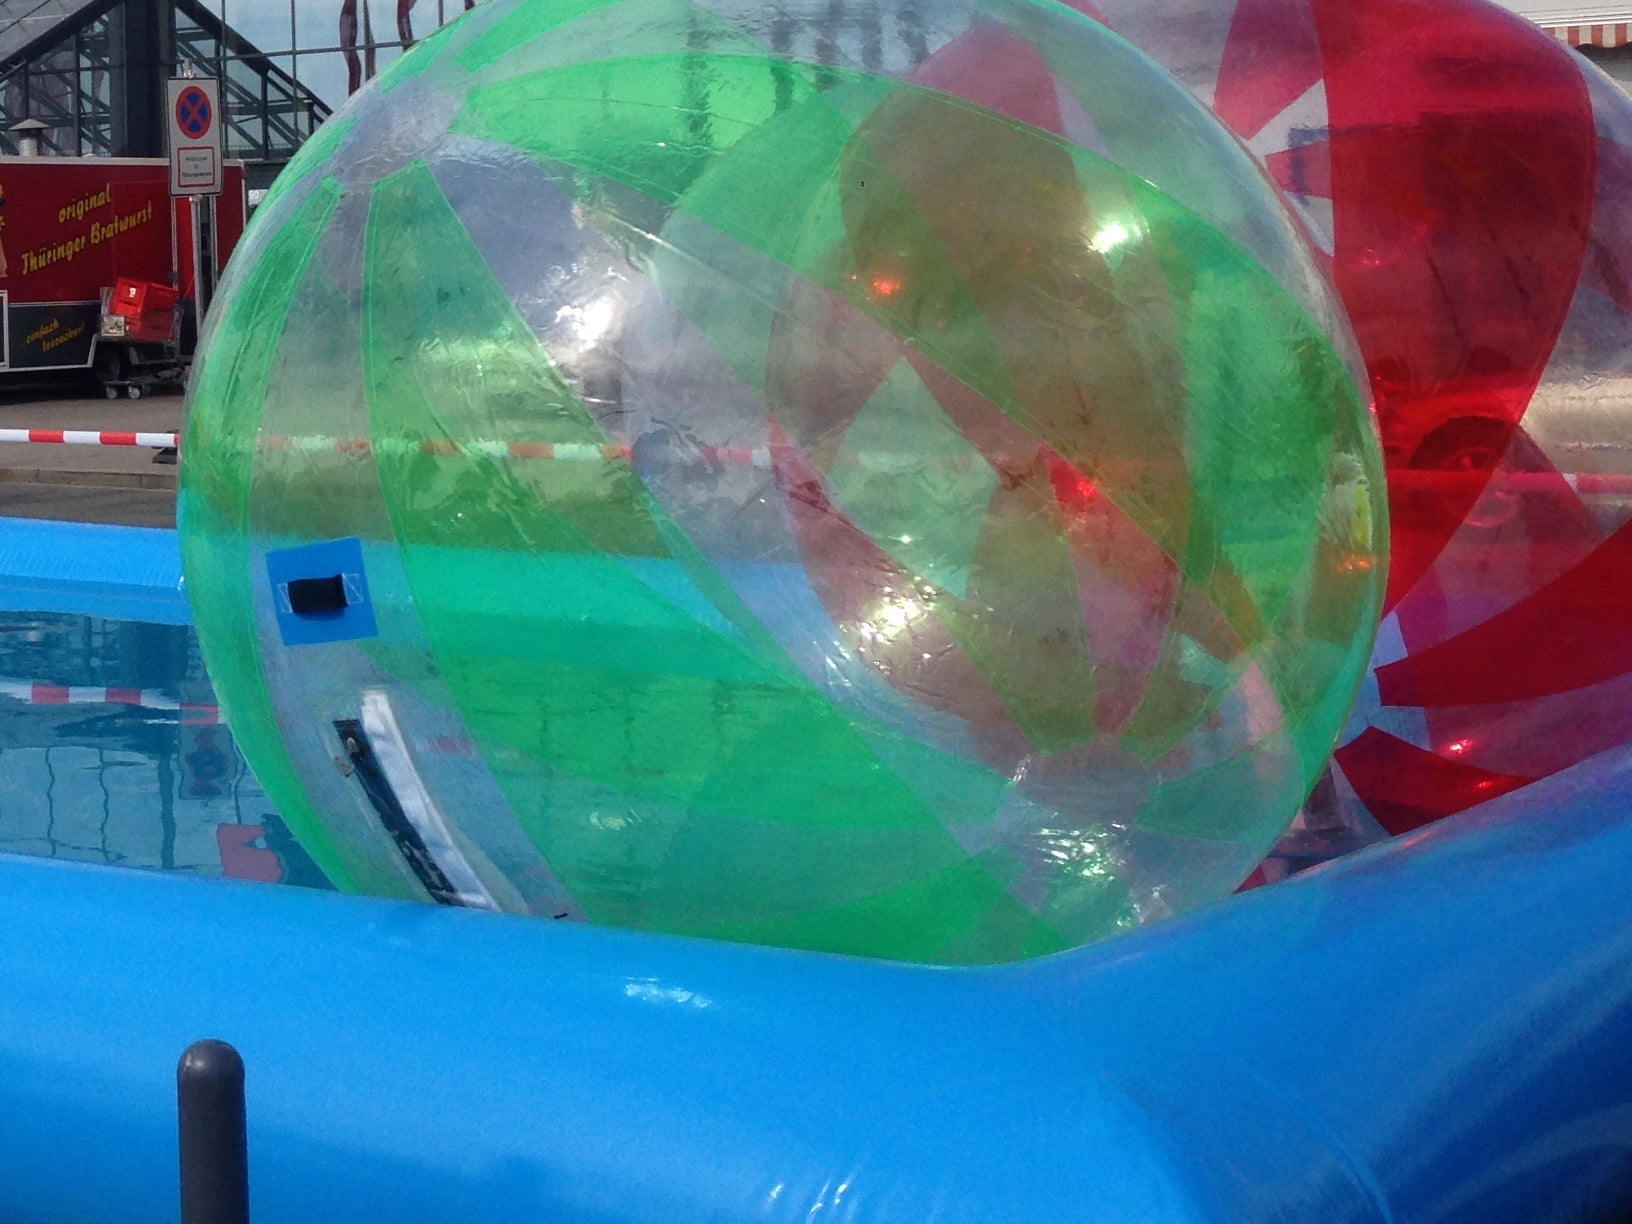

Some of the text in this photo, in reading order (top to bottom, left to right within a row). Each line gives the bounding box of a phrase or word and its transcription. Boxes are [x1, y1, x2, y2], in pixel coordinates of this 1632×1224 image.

[58, 182, 111, 223] original
[21, 200, 152, 275] Thüringer Bratwurst
